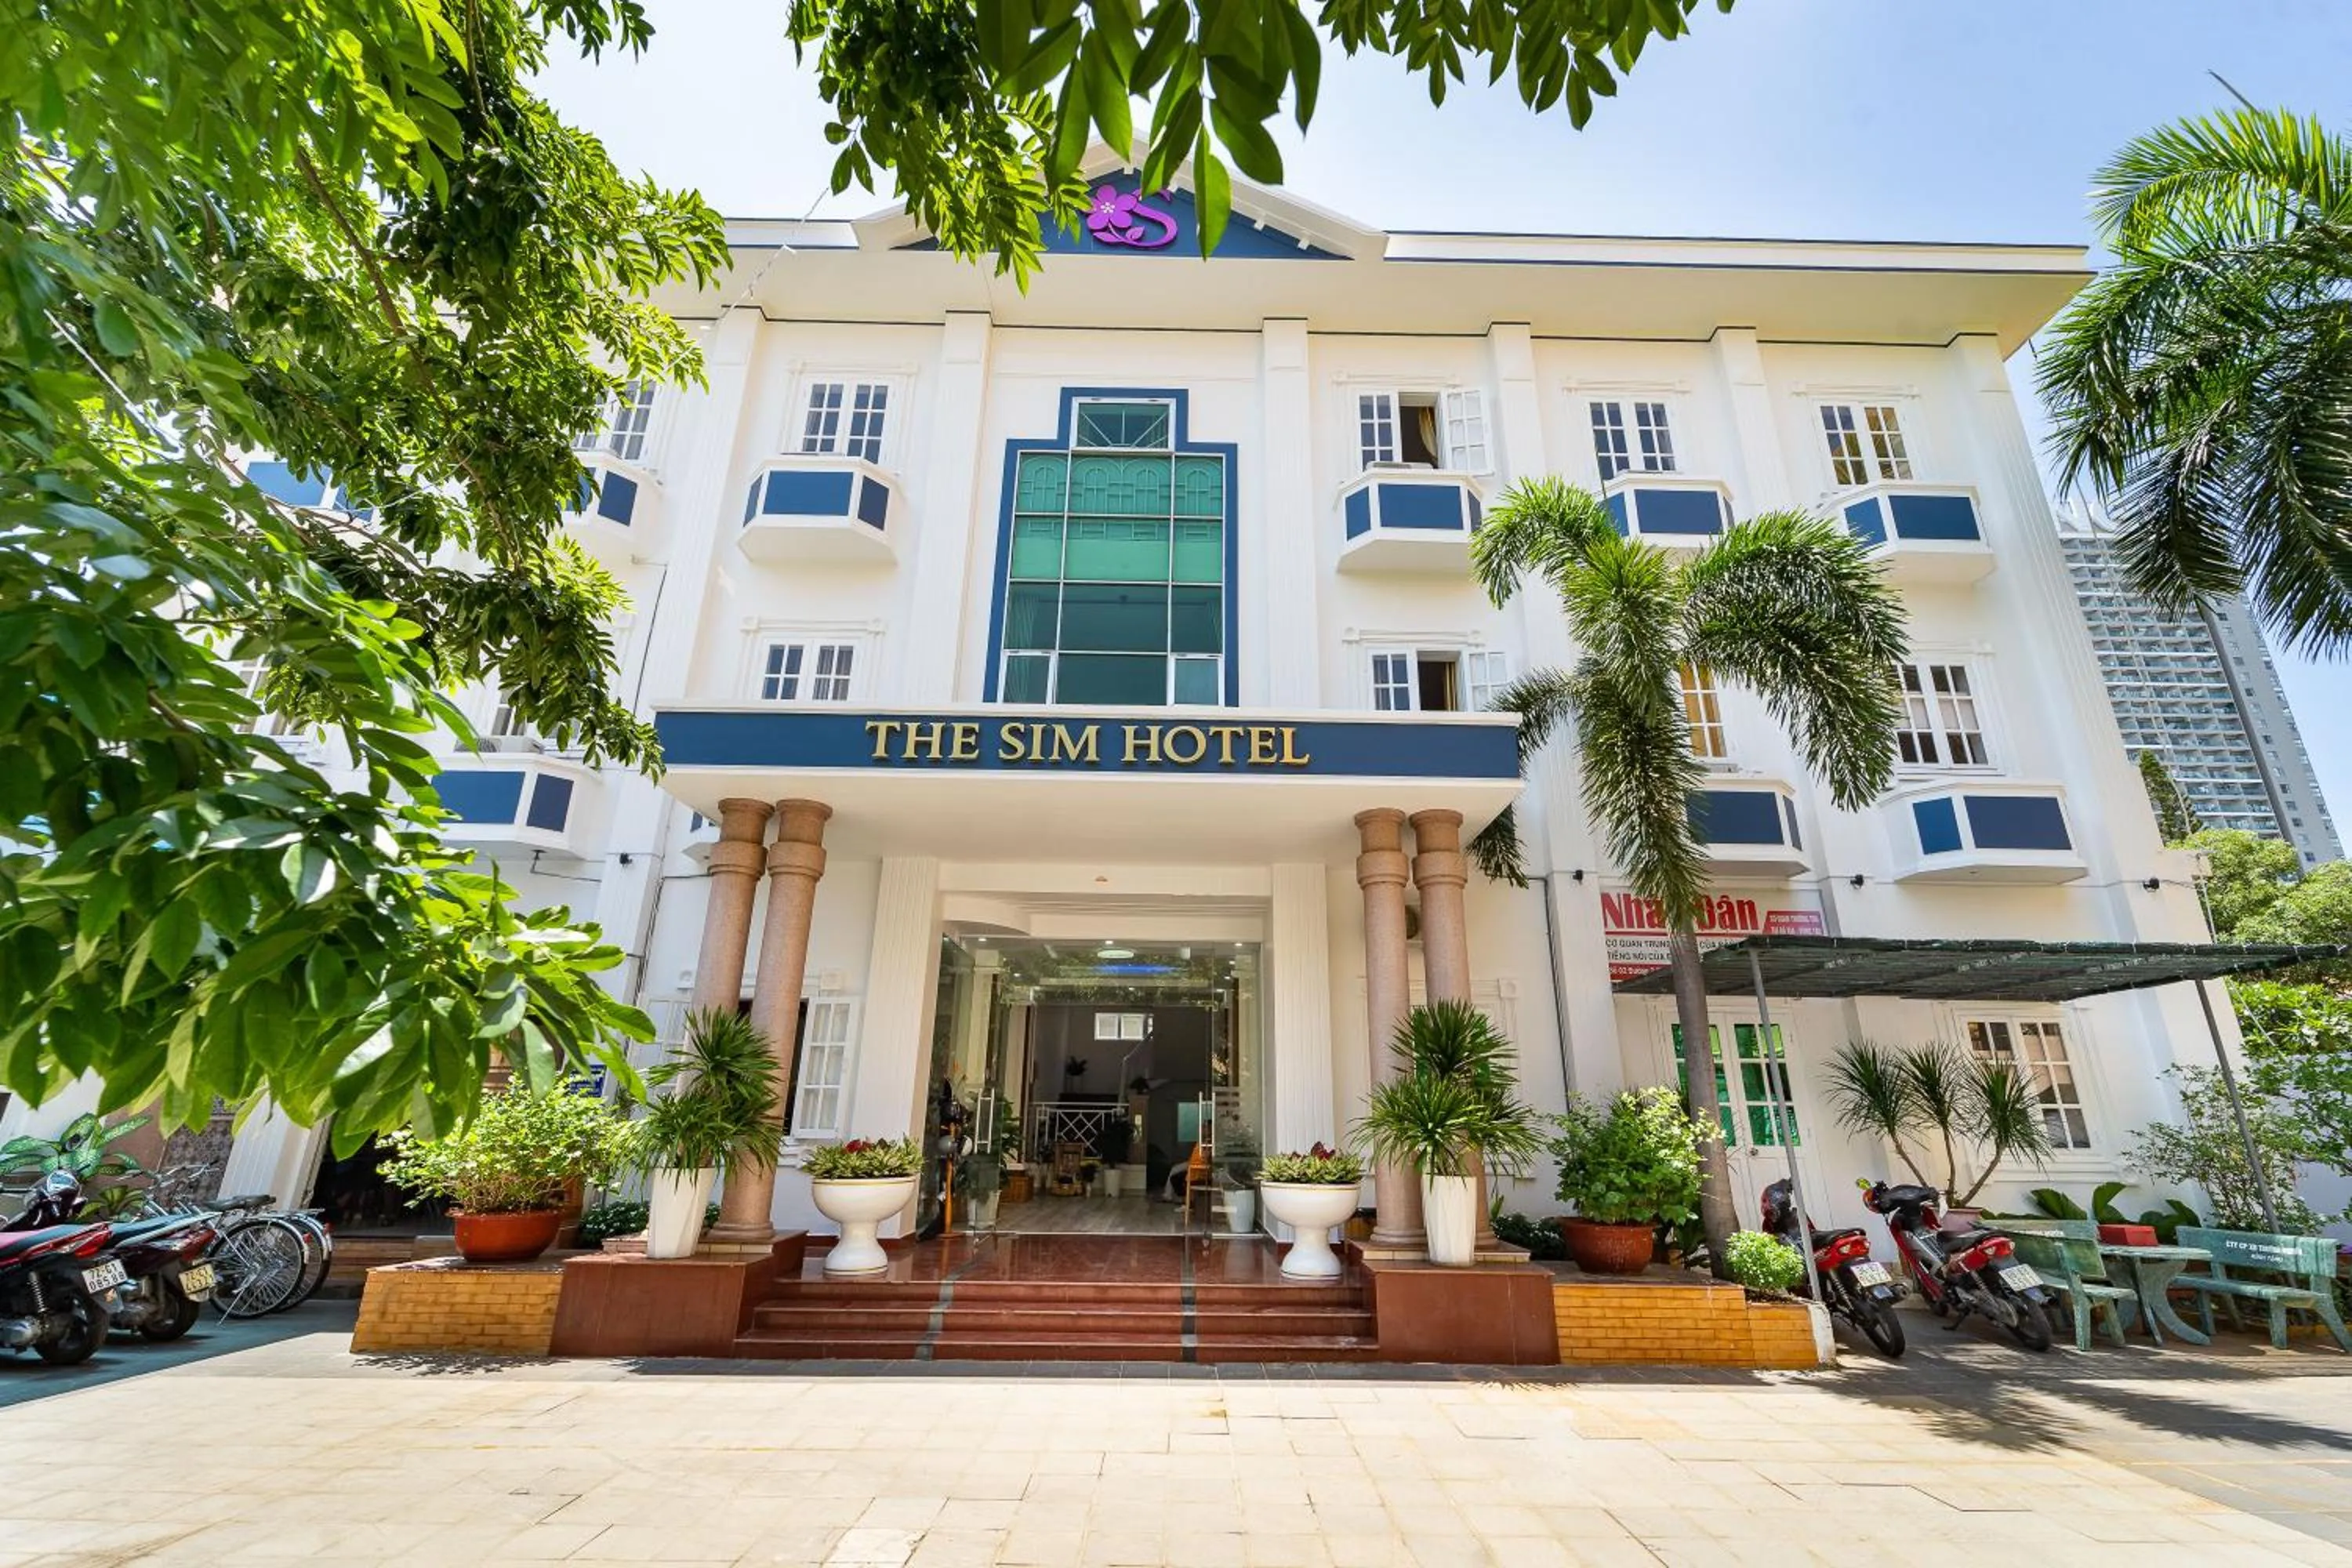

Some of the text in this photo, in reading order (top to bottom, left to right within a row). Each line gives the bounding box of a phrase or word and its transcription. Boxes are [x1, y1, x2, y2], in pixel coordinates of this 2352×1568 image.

[865, 720, 1310, 766] THE SIM HOTEL
